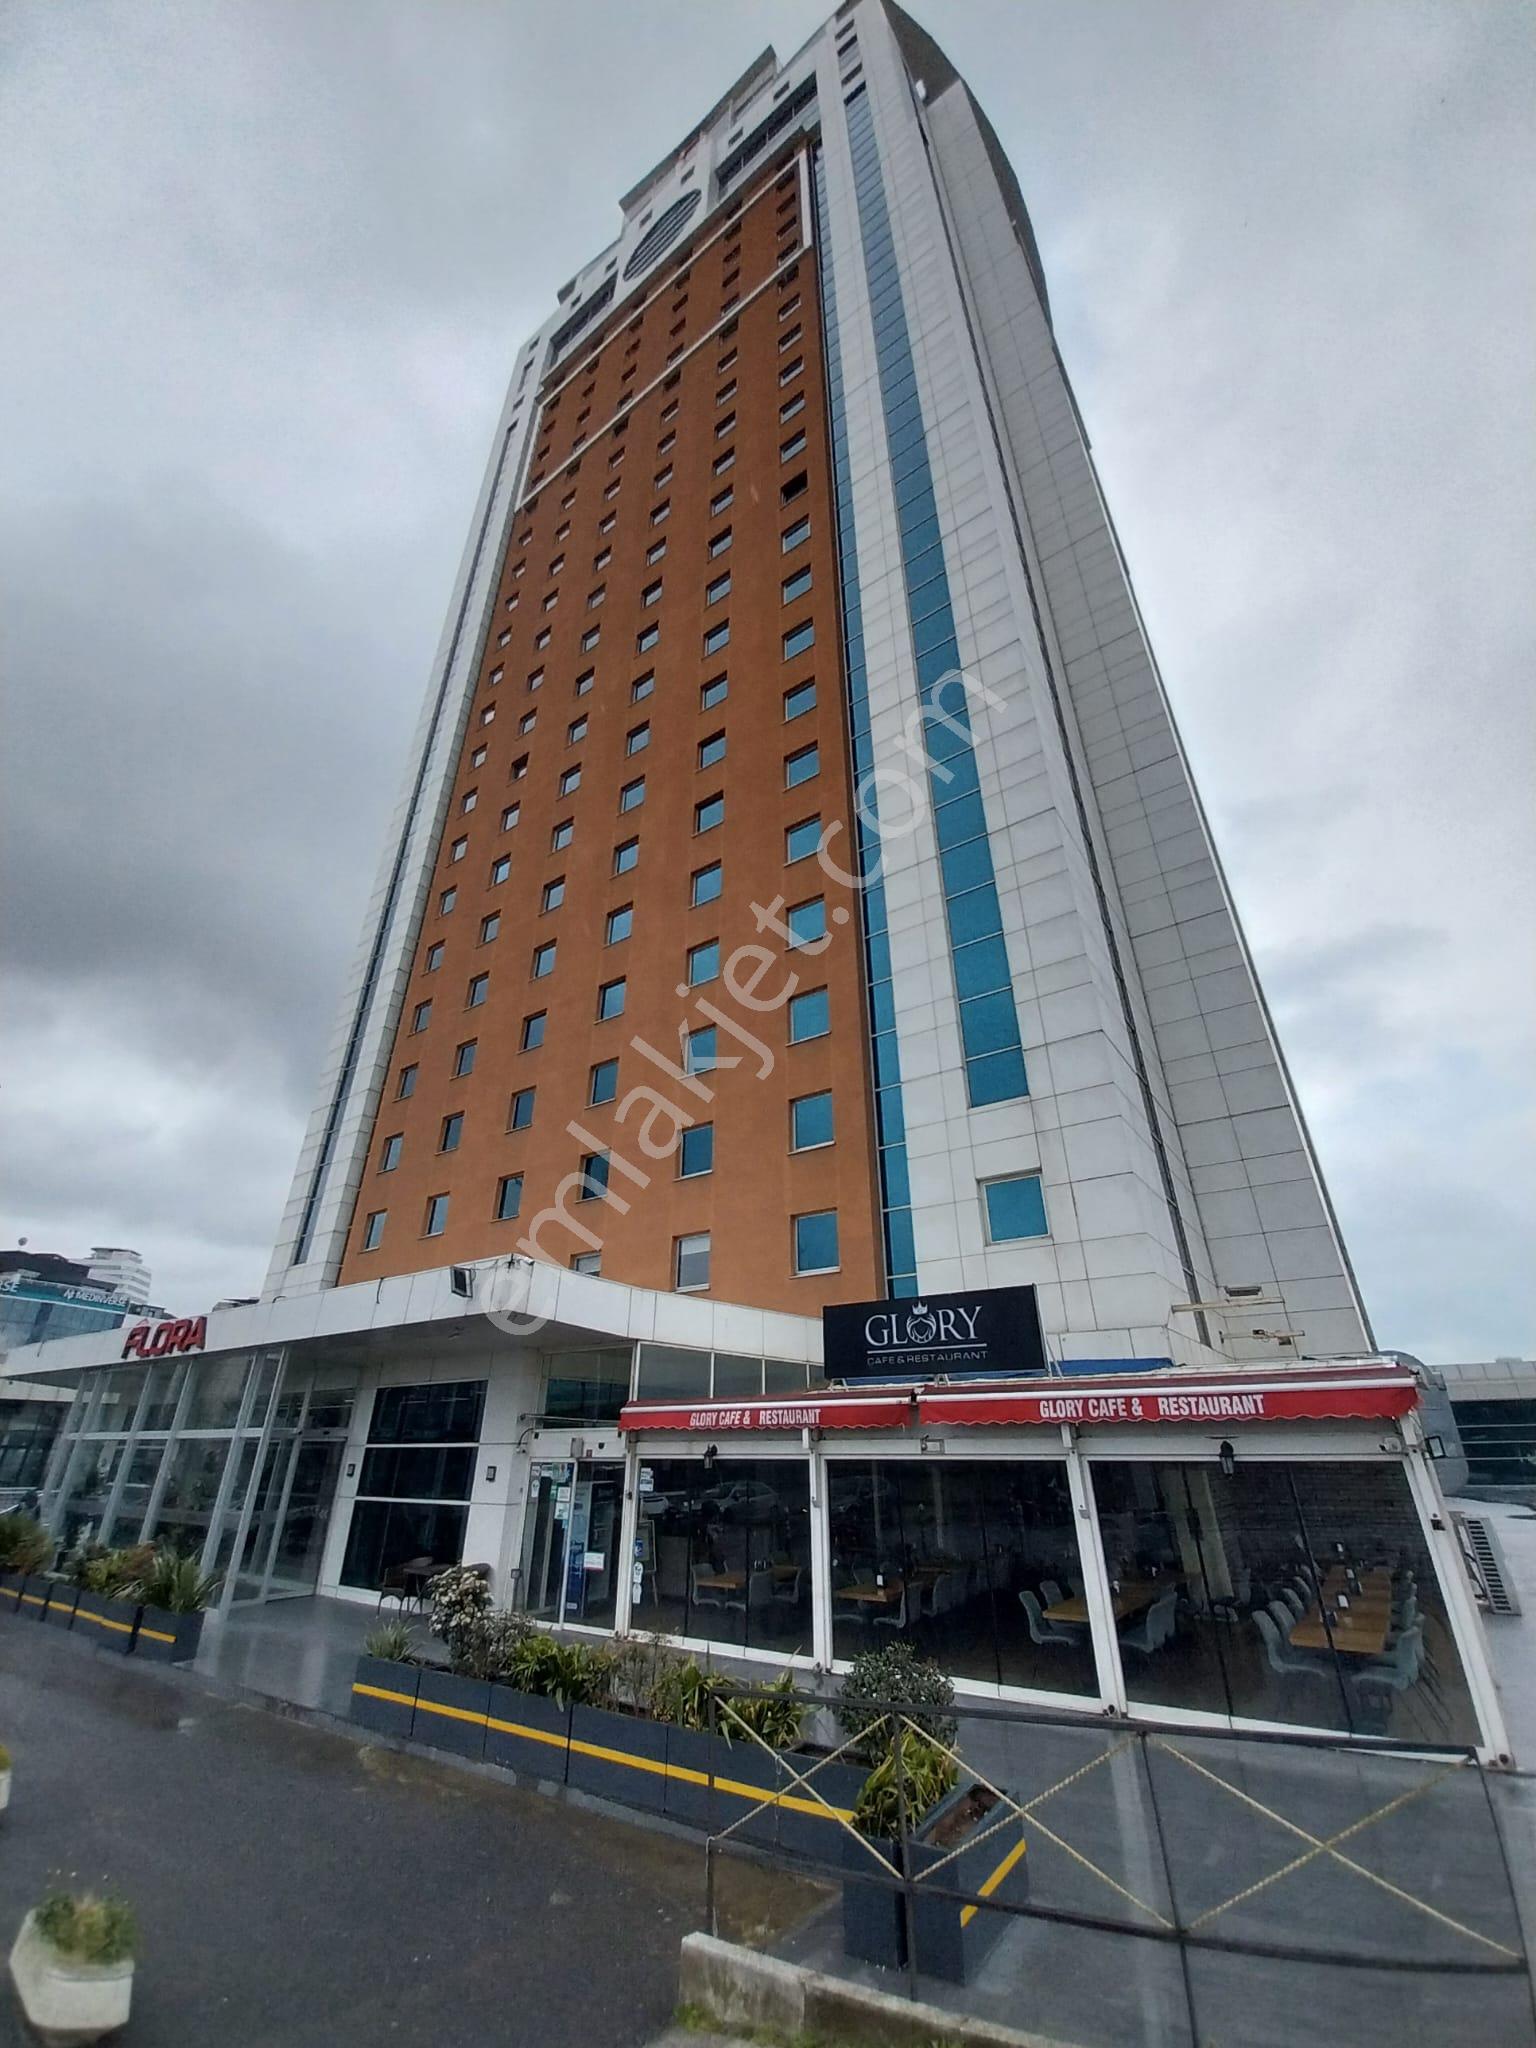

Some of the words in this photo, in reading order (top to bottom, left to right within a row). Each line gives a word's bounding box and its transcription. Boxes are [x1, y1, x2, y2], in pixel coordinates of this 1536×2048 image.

[865, 1305, 982, 1346] GLORY
[121, 1316, 207, 1360] FLORA
[867, 1356, 895, 1366] CAFE
[906, 1351, 988, 1363] RESTAURANT
[690, 1411, 718, 1427] GLORY
[719, 1410, 742, 1425] CAFE
[743, 1410, 751, 1425] &
[759, 1408, 821, 1425] RESTAURANT
[1039, 1400, 1084, 1418] GLORY
[1088, 1398, 1127, 1417] CAFE
[1131, 1397, 1144, 1416] &
[1157, 1394, 1264, 1416] RESTAURANT
